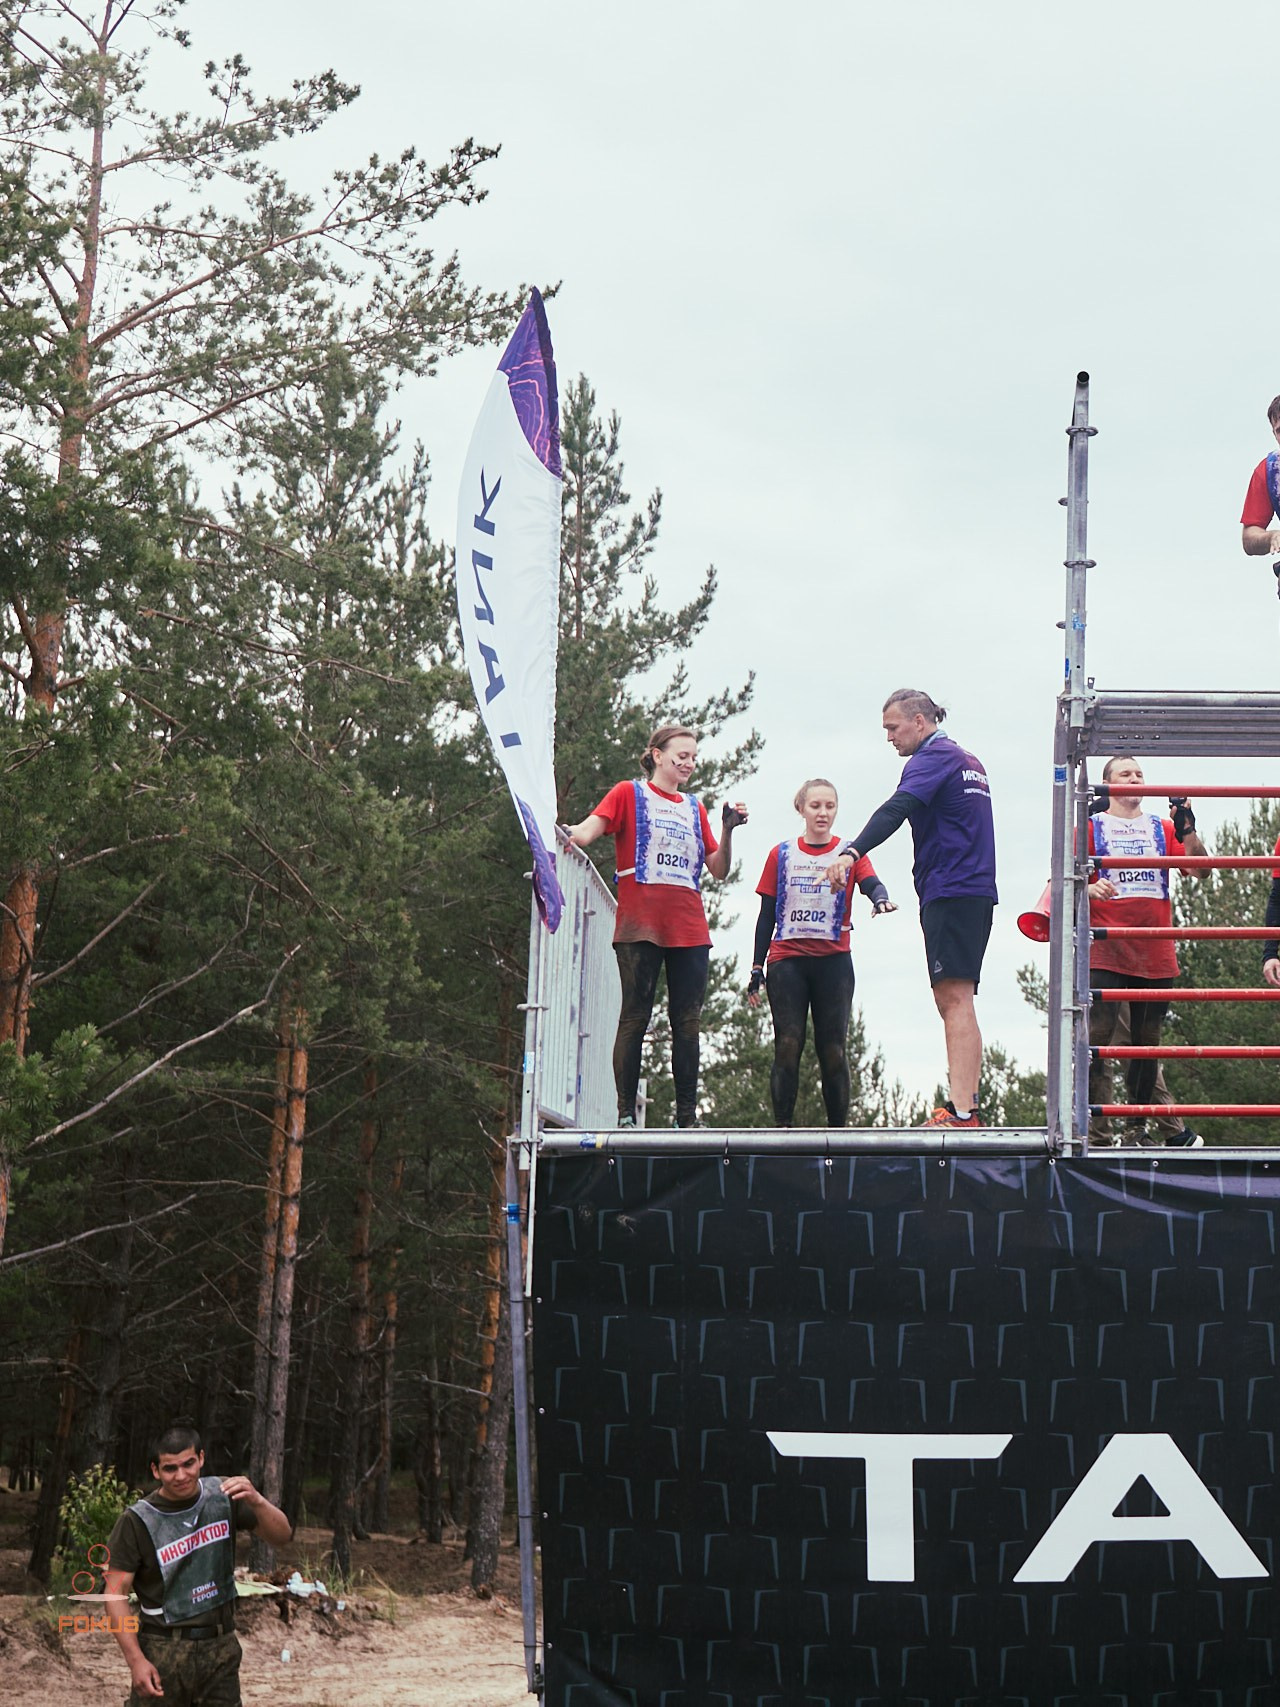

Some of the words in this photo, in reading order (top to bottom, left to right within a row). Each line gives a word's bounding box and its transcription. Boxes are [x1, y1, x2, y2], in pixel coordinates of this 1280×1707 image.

[1119, 870, 1155, 883] 03206
[790, 910, 826, 923] 03202
[160, 1522, 228, 1563] ИНСТРУКТОР
[192, 1581, 216, 1595] ГОНКА
